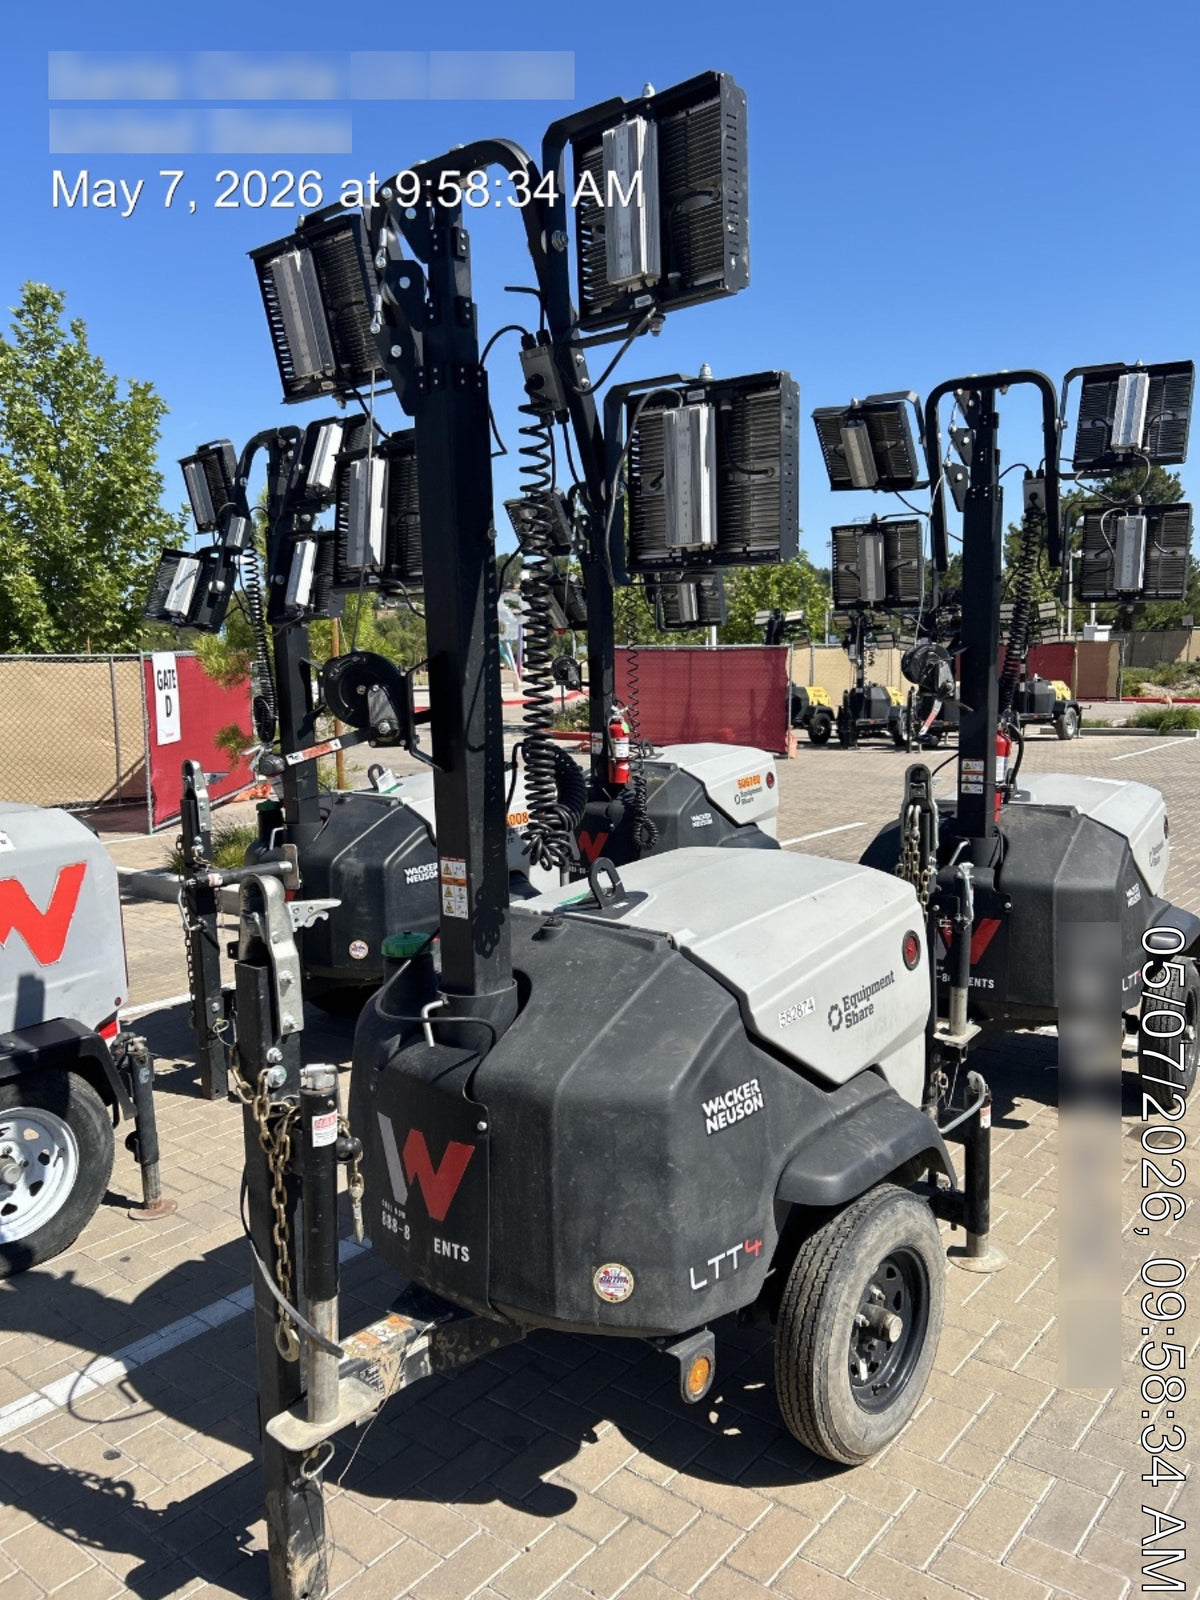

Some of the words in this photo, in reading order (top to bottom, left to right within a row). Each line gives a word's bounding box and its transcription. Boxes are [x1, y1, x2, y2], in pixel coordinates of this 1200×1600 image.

[156, 669, 176, 691] GATE
[165, 694, 172, 718] D
[506, 811, 529, 827] 008
[842, 969, 895, 1012] Equipment
[779, 997, 816, 1028] 582874
[844, 1003, 874, 1029] Share
[701, 1078, 760, 1118] WACKER
[705, 1092, 764, 1135] NEUSON
[689, 1239, 763, 1291] LTT4
